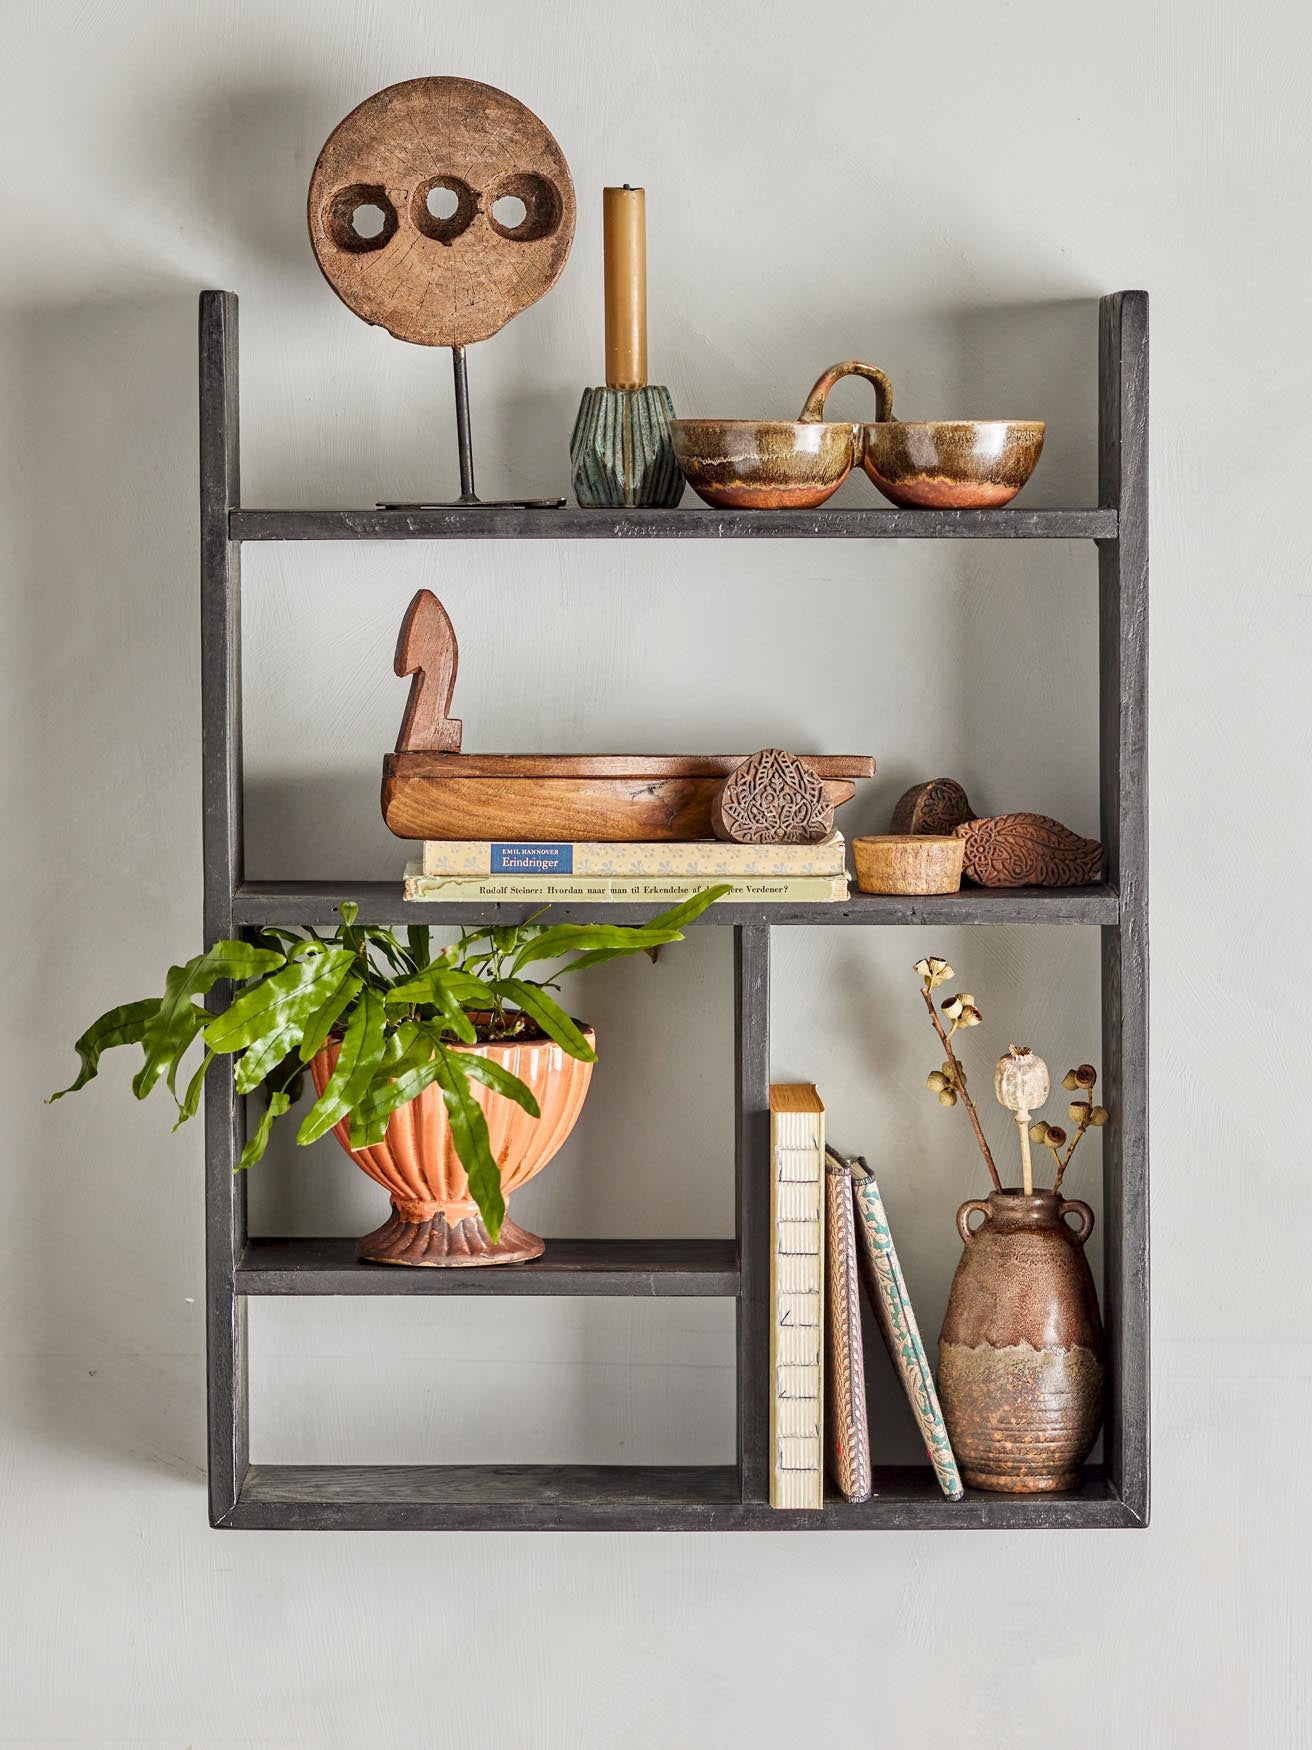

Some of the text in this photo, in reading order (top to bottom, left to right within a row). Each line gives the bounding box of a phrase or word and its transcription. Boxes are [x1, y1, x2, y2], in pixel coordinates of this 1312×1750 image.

[502, 856, 559, 870] Erindringer
[479, 886, 507, 894] Rudolf
[510, 886, 543, 894] Steiner:
[547, 886, 583, 894] Hvordan
[631, 886, 640, 894] til
[643, 885, 689, 894] Erkendelse
[692, 885, 702, 893] af
[746, 885, 788, 893] Verdener?
